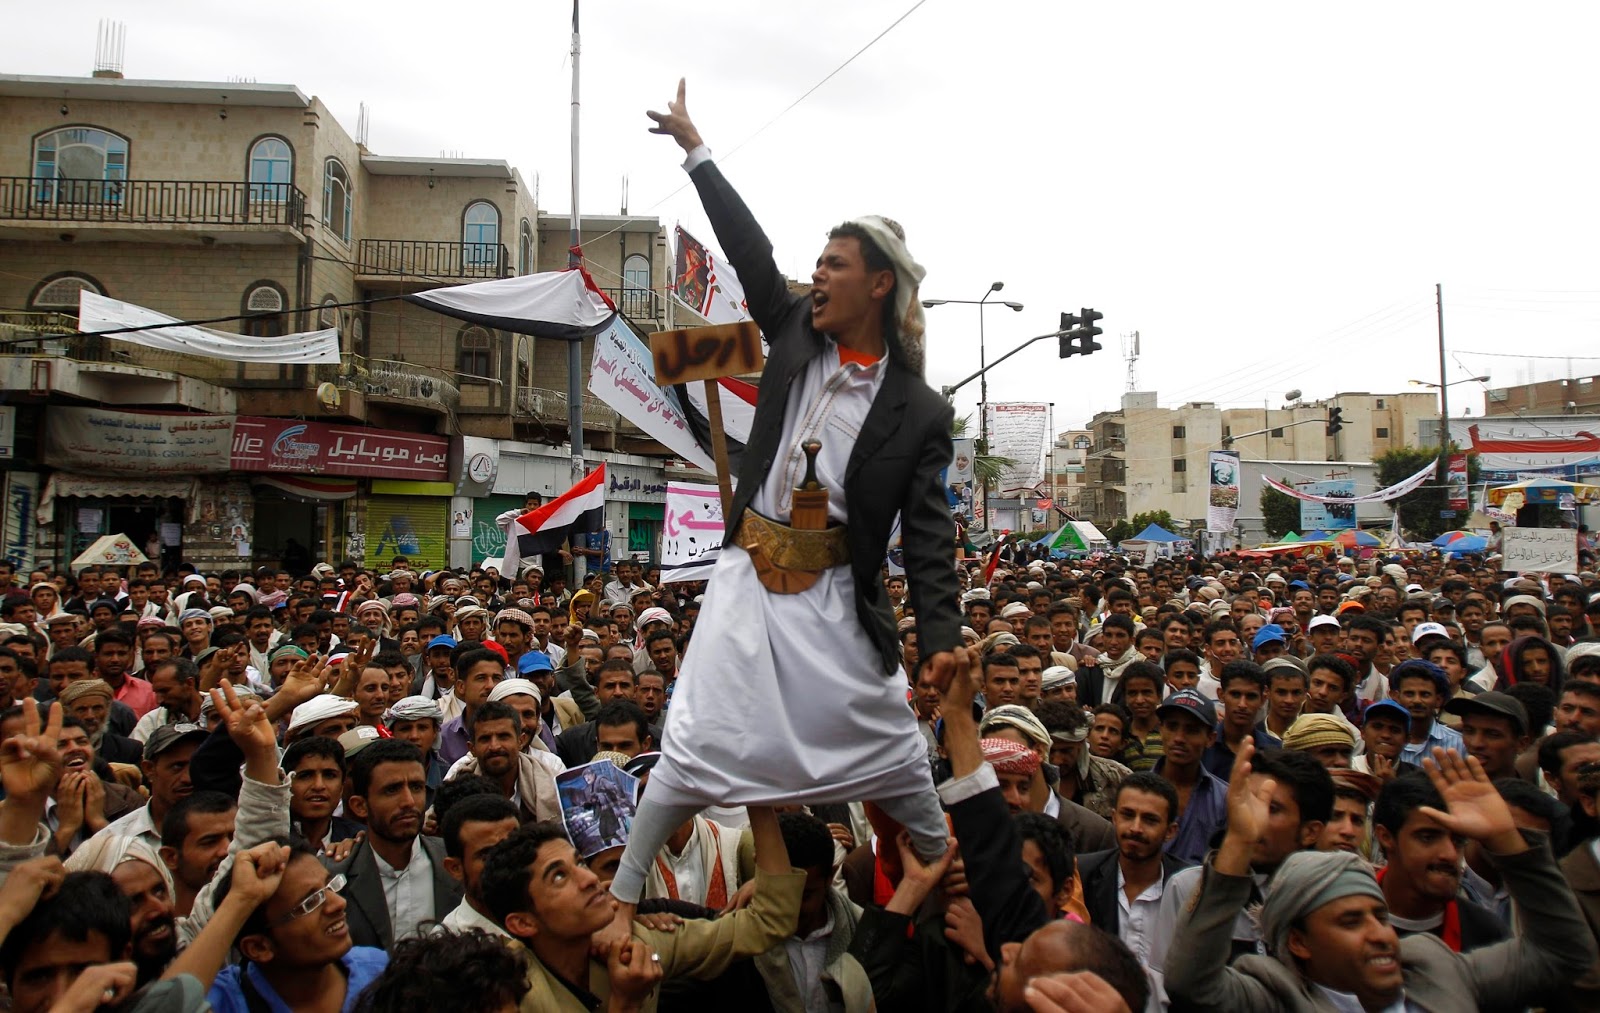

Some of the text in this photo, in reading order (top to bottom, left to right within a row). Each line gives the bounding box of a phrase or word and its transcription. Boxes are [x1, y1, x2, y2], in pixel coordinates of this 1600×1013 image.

[232, 432, 264, 454] ile
[328, 436, 409, 462] موبايل
[415, 445, 447, 467] يمن
